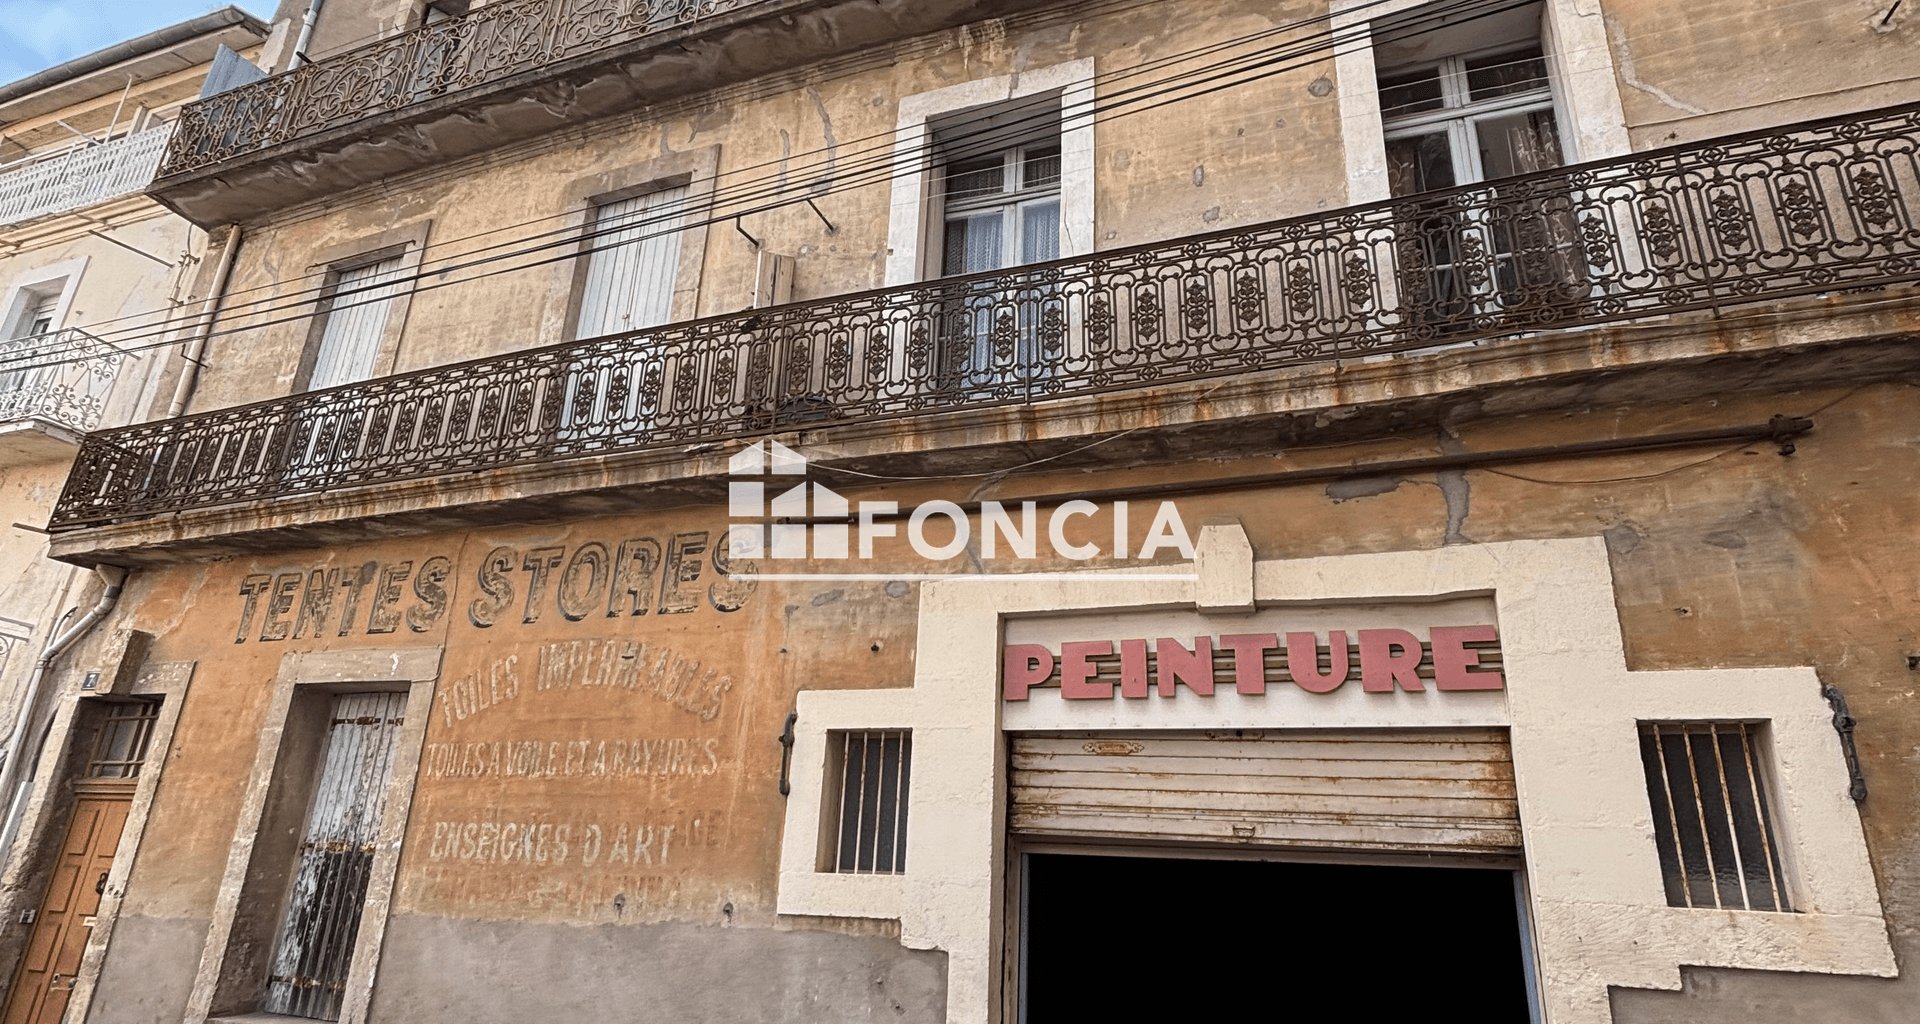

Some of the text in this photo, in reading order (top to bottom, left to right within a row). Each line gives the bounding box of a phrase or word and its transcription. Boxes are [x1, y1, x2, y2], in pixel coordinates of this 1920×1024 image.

[234, 529, 760, 645] TENTES STORES
[437, 654, 520, 728] TOILES
[1003, 625, 1504, 700] PEINTURE
[426, 741, 488, 780] TOILES
[505, 739, 560, 779] VOILE
[564, 740, 591, 776] ET
[430, 821, 571, 866] ENSEIGNES
